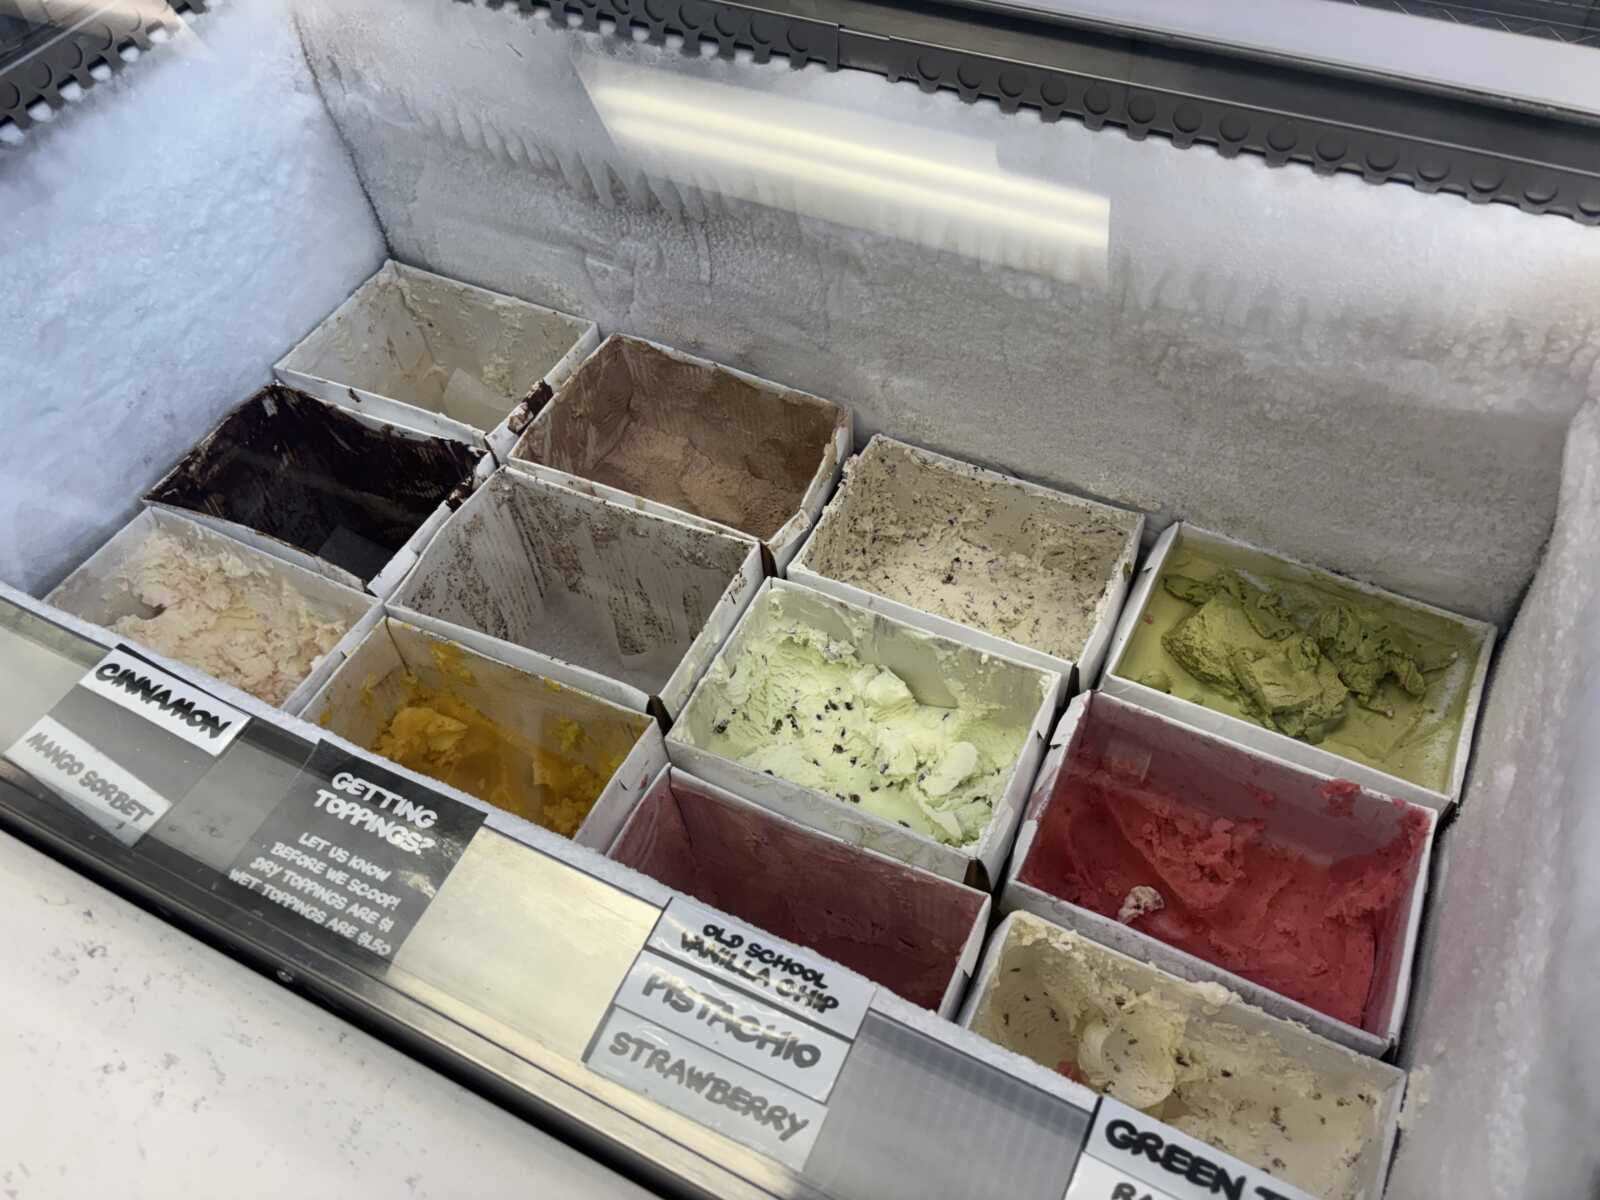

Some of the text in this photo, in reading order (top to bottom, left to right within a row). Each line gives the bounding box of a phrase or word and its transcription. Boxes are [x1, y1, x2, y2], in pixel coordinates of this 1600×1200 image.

[96, 663, 232, 739] CINNAMON
[26, 732, 154, 822] MANGO SORBET
[332, 772, 438, 828] GETTING
[298, 832, 392, 882] LET US KNOW
[314, 788, 435, 855] TOPPINGS?
[228, 869, 262, 890] WET
[262, 884, 326, 923] TOPPINGS
[325, 917, 357, 939] ARE
[250, 857, 394, 932] DRY TOPPINGS ARE $1
[270, 842, 401, 910] BEFORE WE SCOOP!
[702, 924, 828, 989] OLD SCHOOL
[642, 974, 821, 1068] PISTACHIO
[608, 1032, 808, 1142] STRAWBERRY
[1105, 1119, 1246, 1200] GREEN
